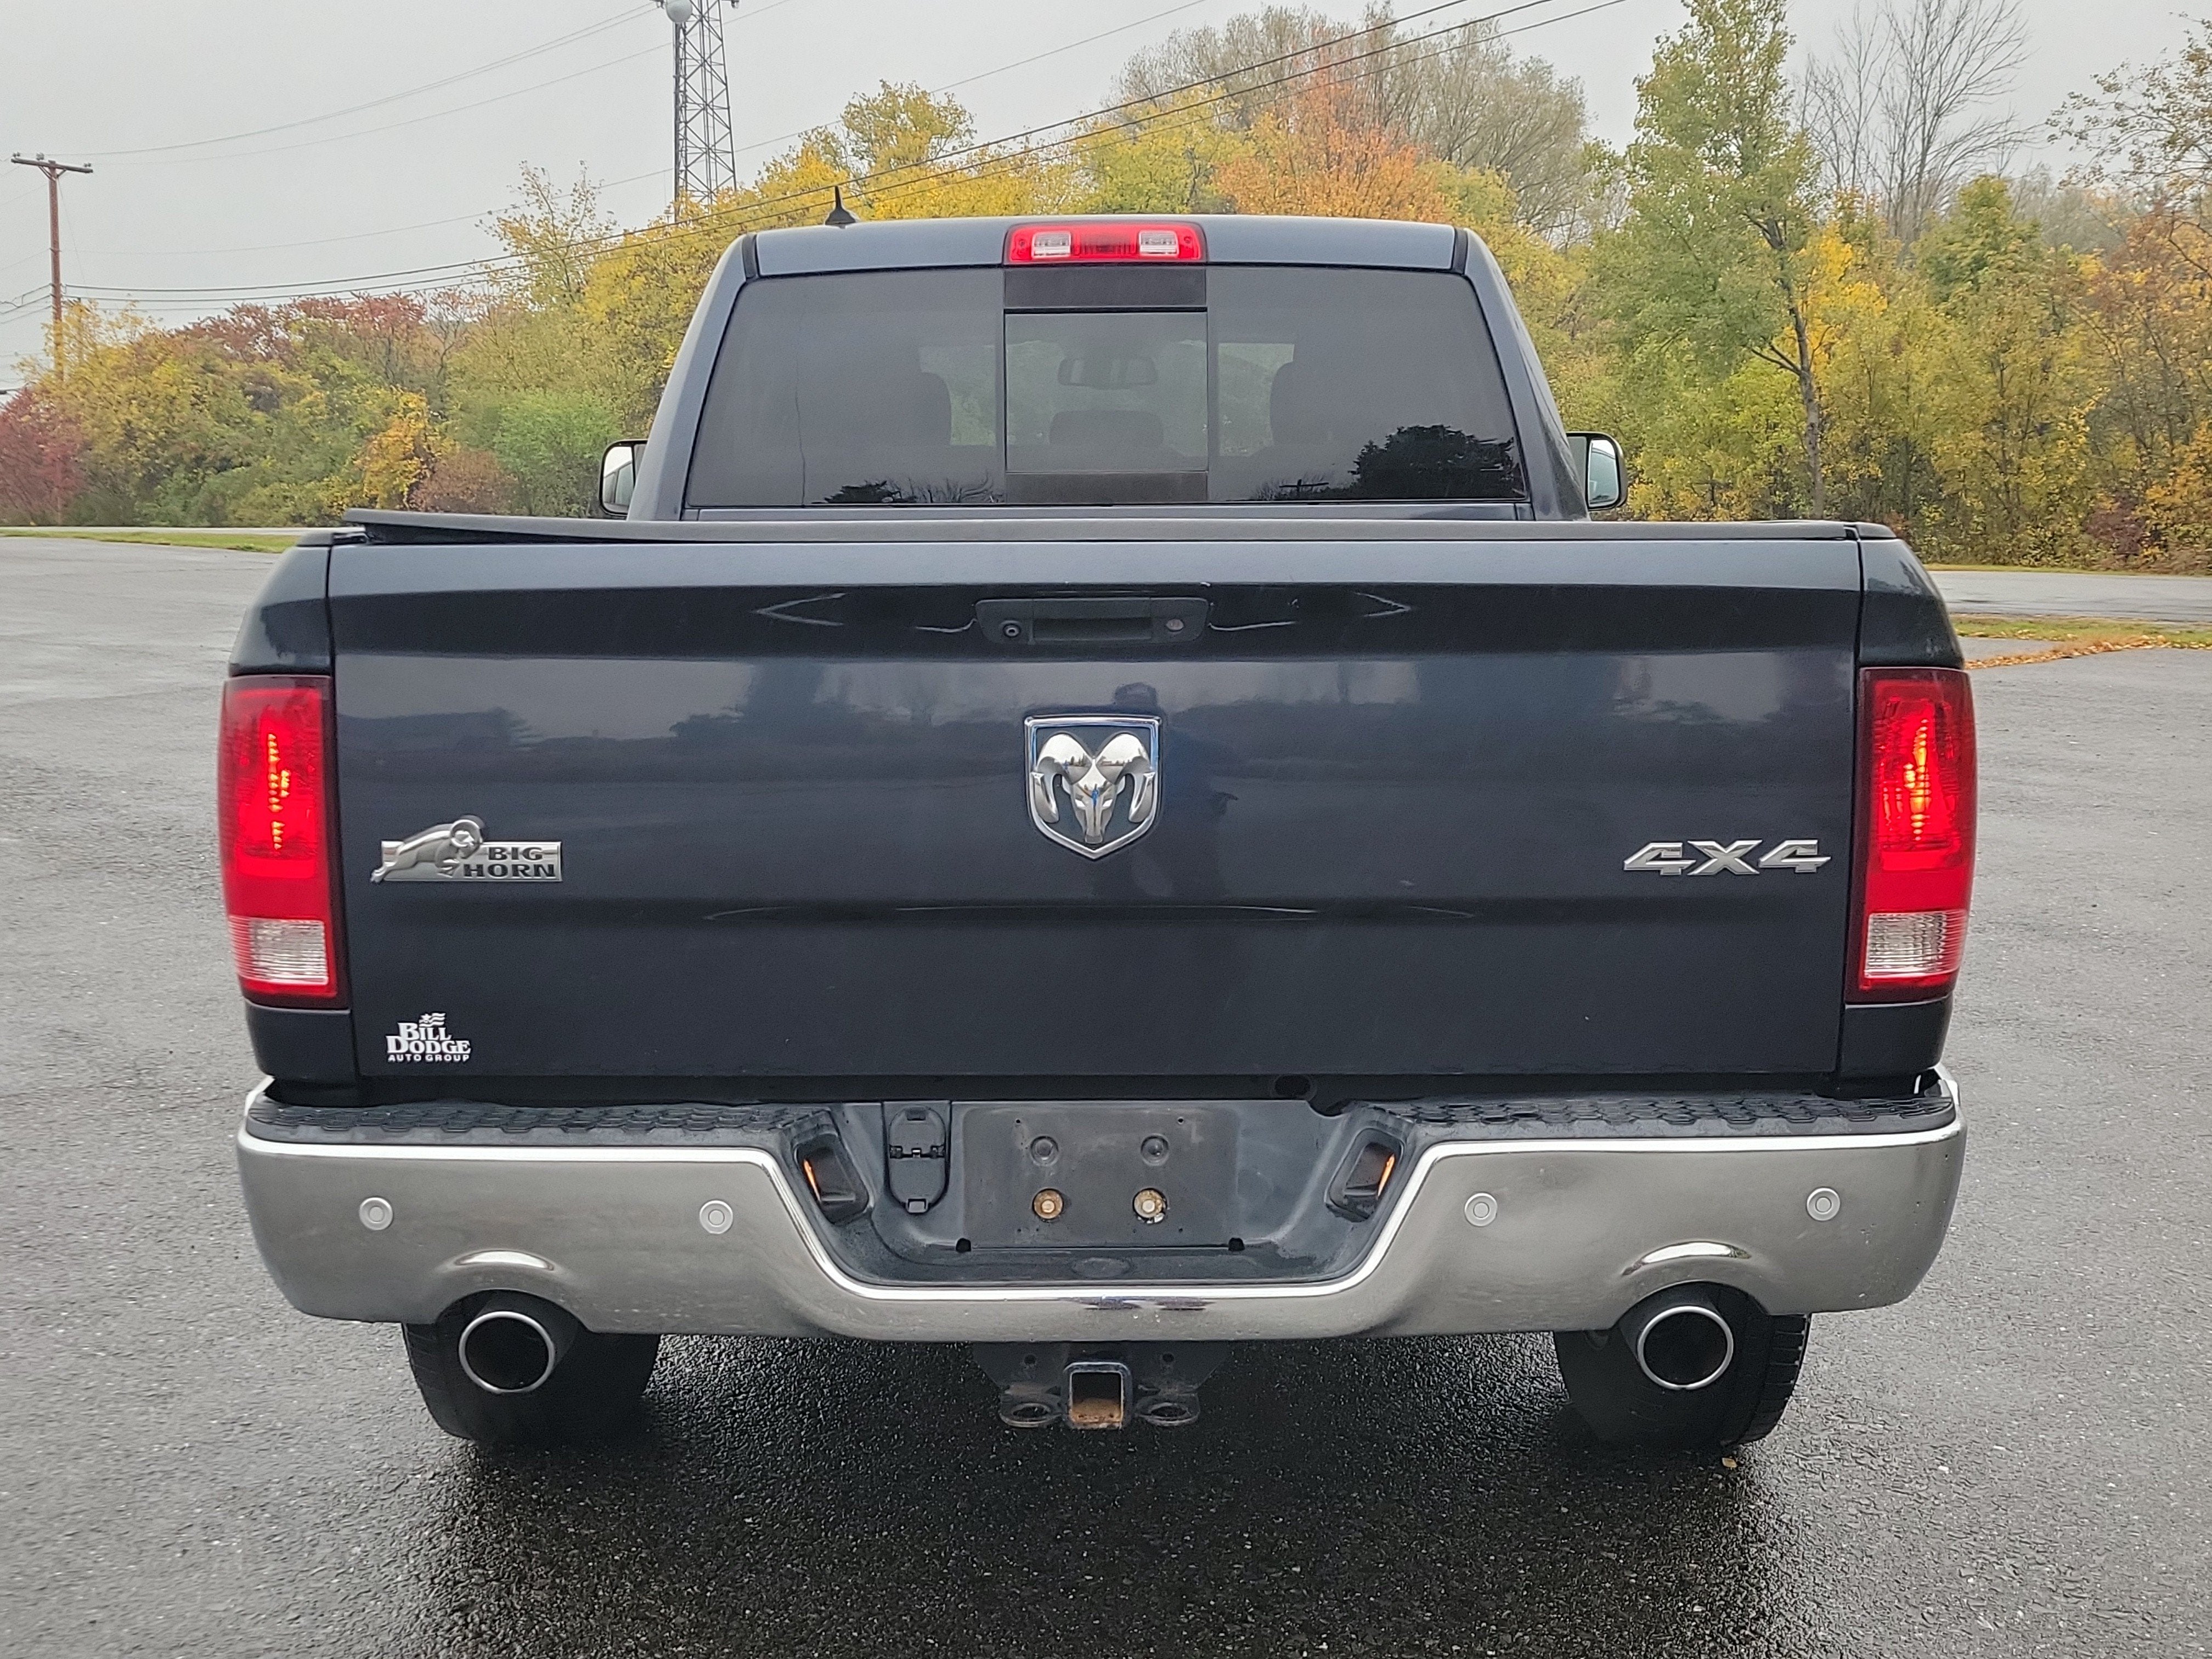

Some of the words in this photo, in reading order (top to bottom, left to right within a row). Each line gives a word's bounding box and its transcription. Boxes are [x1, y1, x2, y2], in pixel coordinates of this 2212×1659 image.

[488, 847, 543, 861] BIG
[1623, 839, 1832, 876] 4X4
[463, 864, 556, 878] HORN
[397, 1022, 453, 1041] BILL
[386, 1035, 471, 1054] DODGE
[388, 1053, 422, 1063] AUTO
[425, 1053, 470, 1063] GROUP
